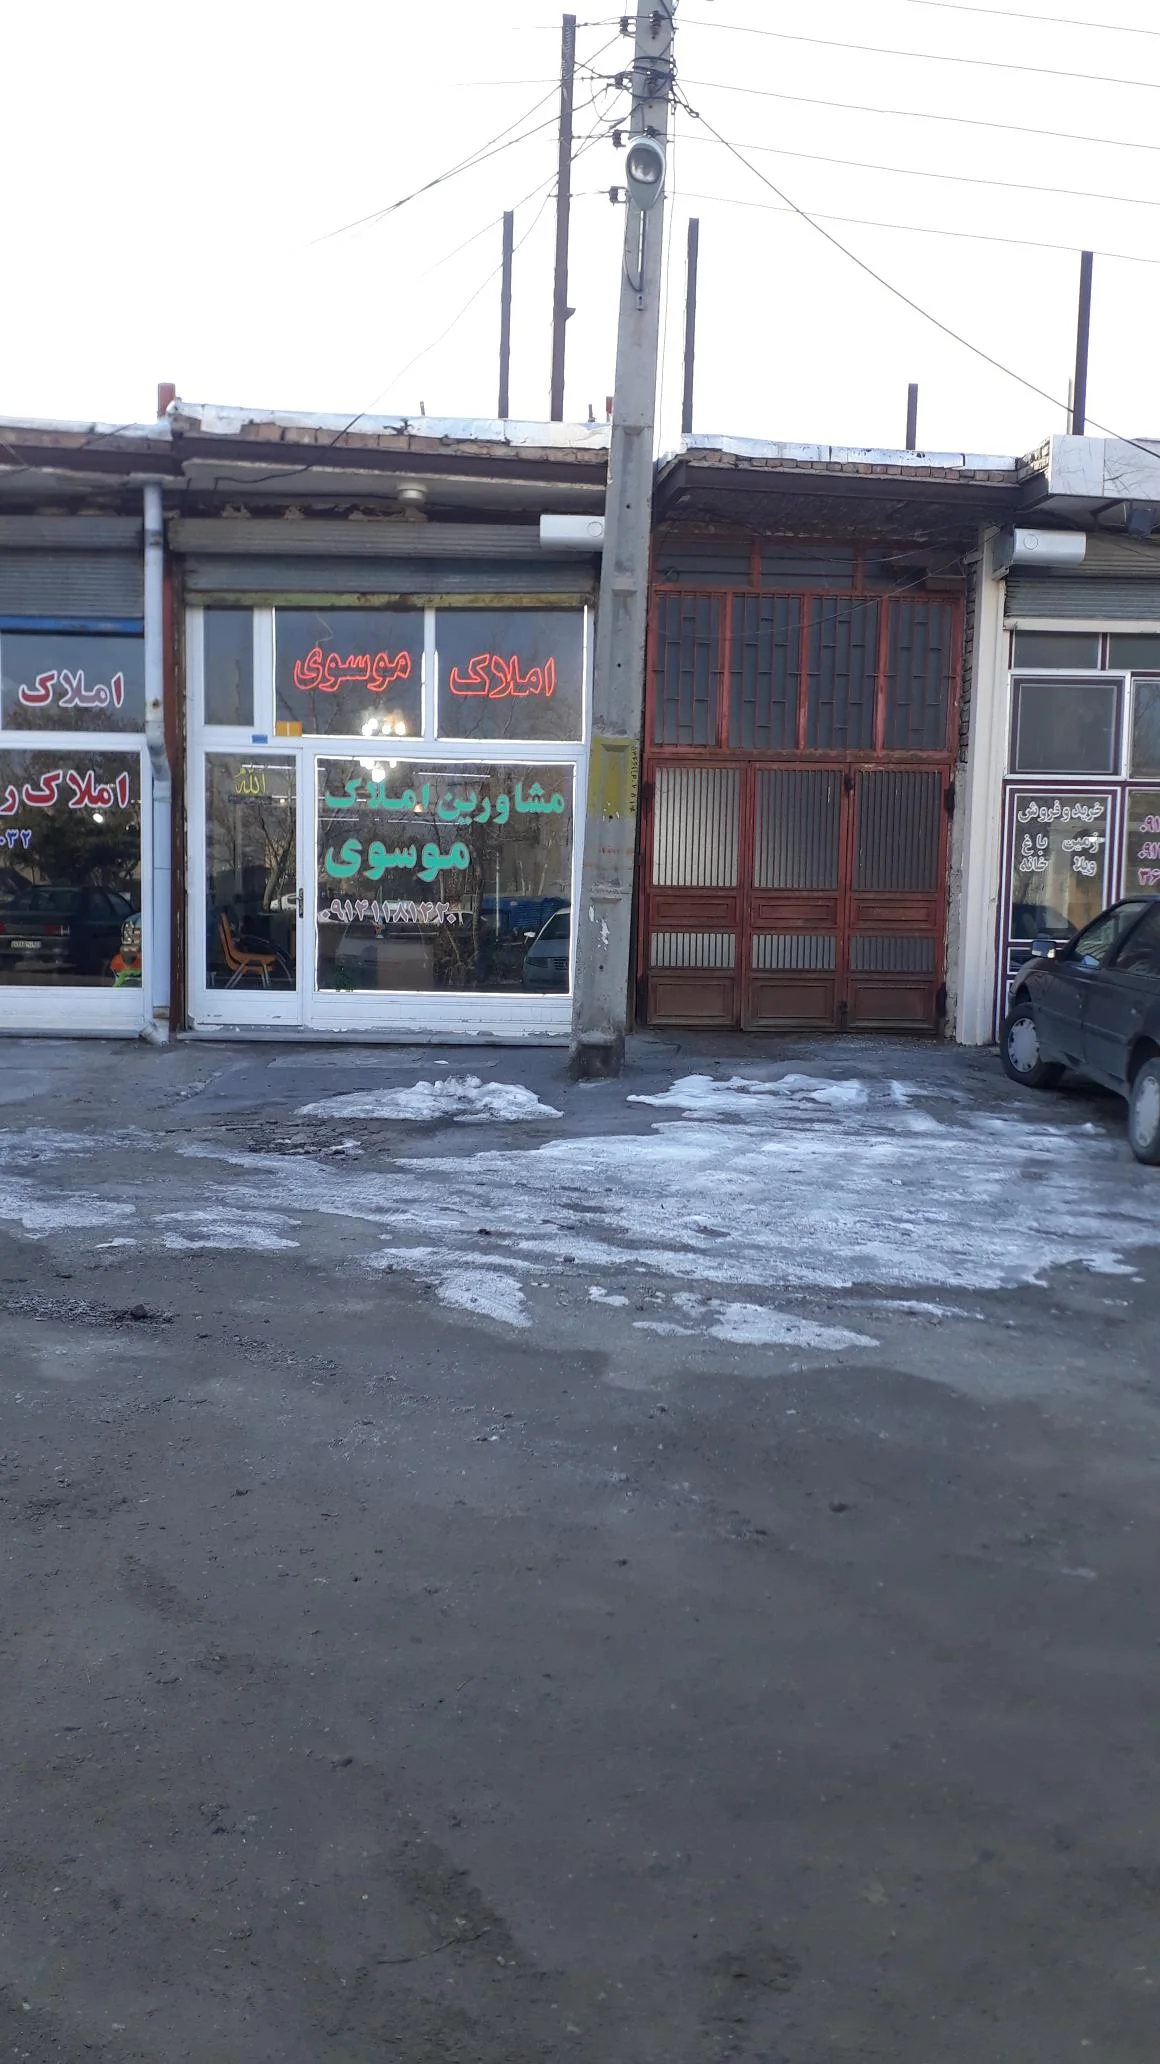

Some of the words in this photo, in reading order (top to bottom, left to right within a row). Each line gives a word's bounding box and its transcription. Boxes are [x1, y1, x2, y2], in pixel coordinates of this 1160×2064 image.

[292, 645, 411, 691] موسوی
[449, 653, 556, 698] املاک
[19, 669, 125, 708] املاک
[23, 769, 130, 809] املاک
[324, 778, 431, 810] املاک
[437, 782, 565, 825] مشاورین
[1017, 799, 1062, 823] فروش
[1062, 806, 1071, 822] و
[1071, 801, 1105, 822] خرید
[325, 835, 470, 881] موسوی
[1061, 832, 1101, 853] زمین
[1019, 856, 1049, 872] خانه
[1072, 856, 1098, 877] ویلا
